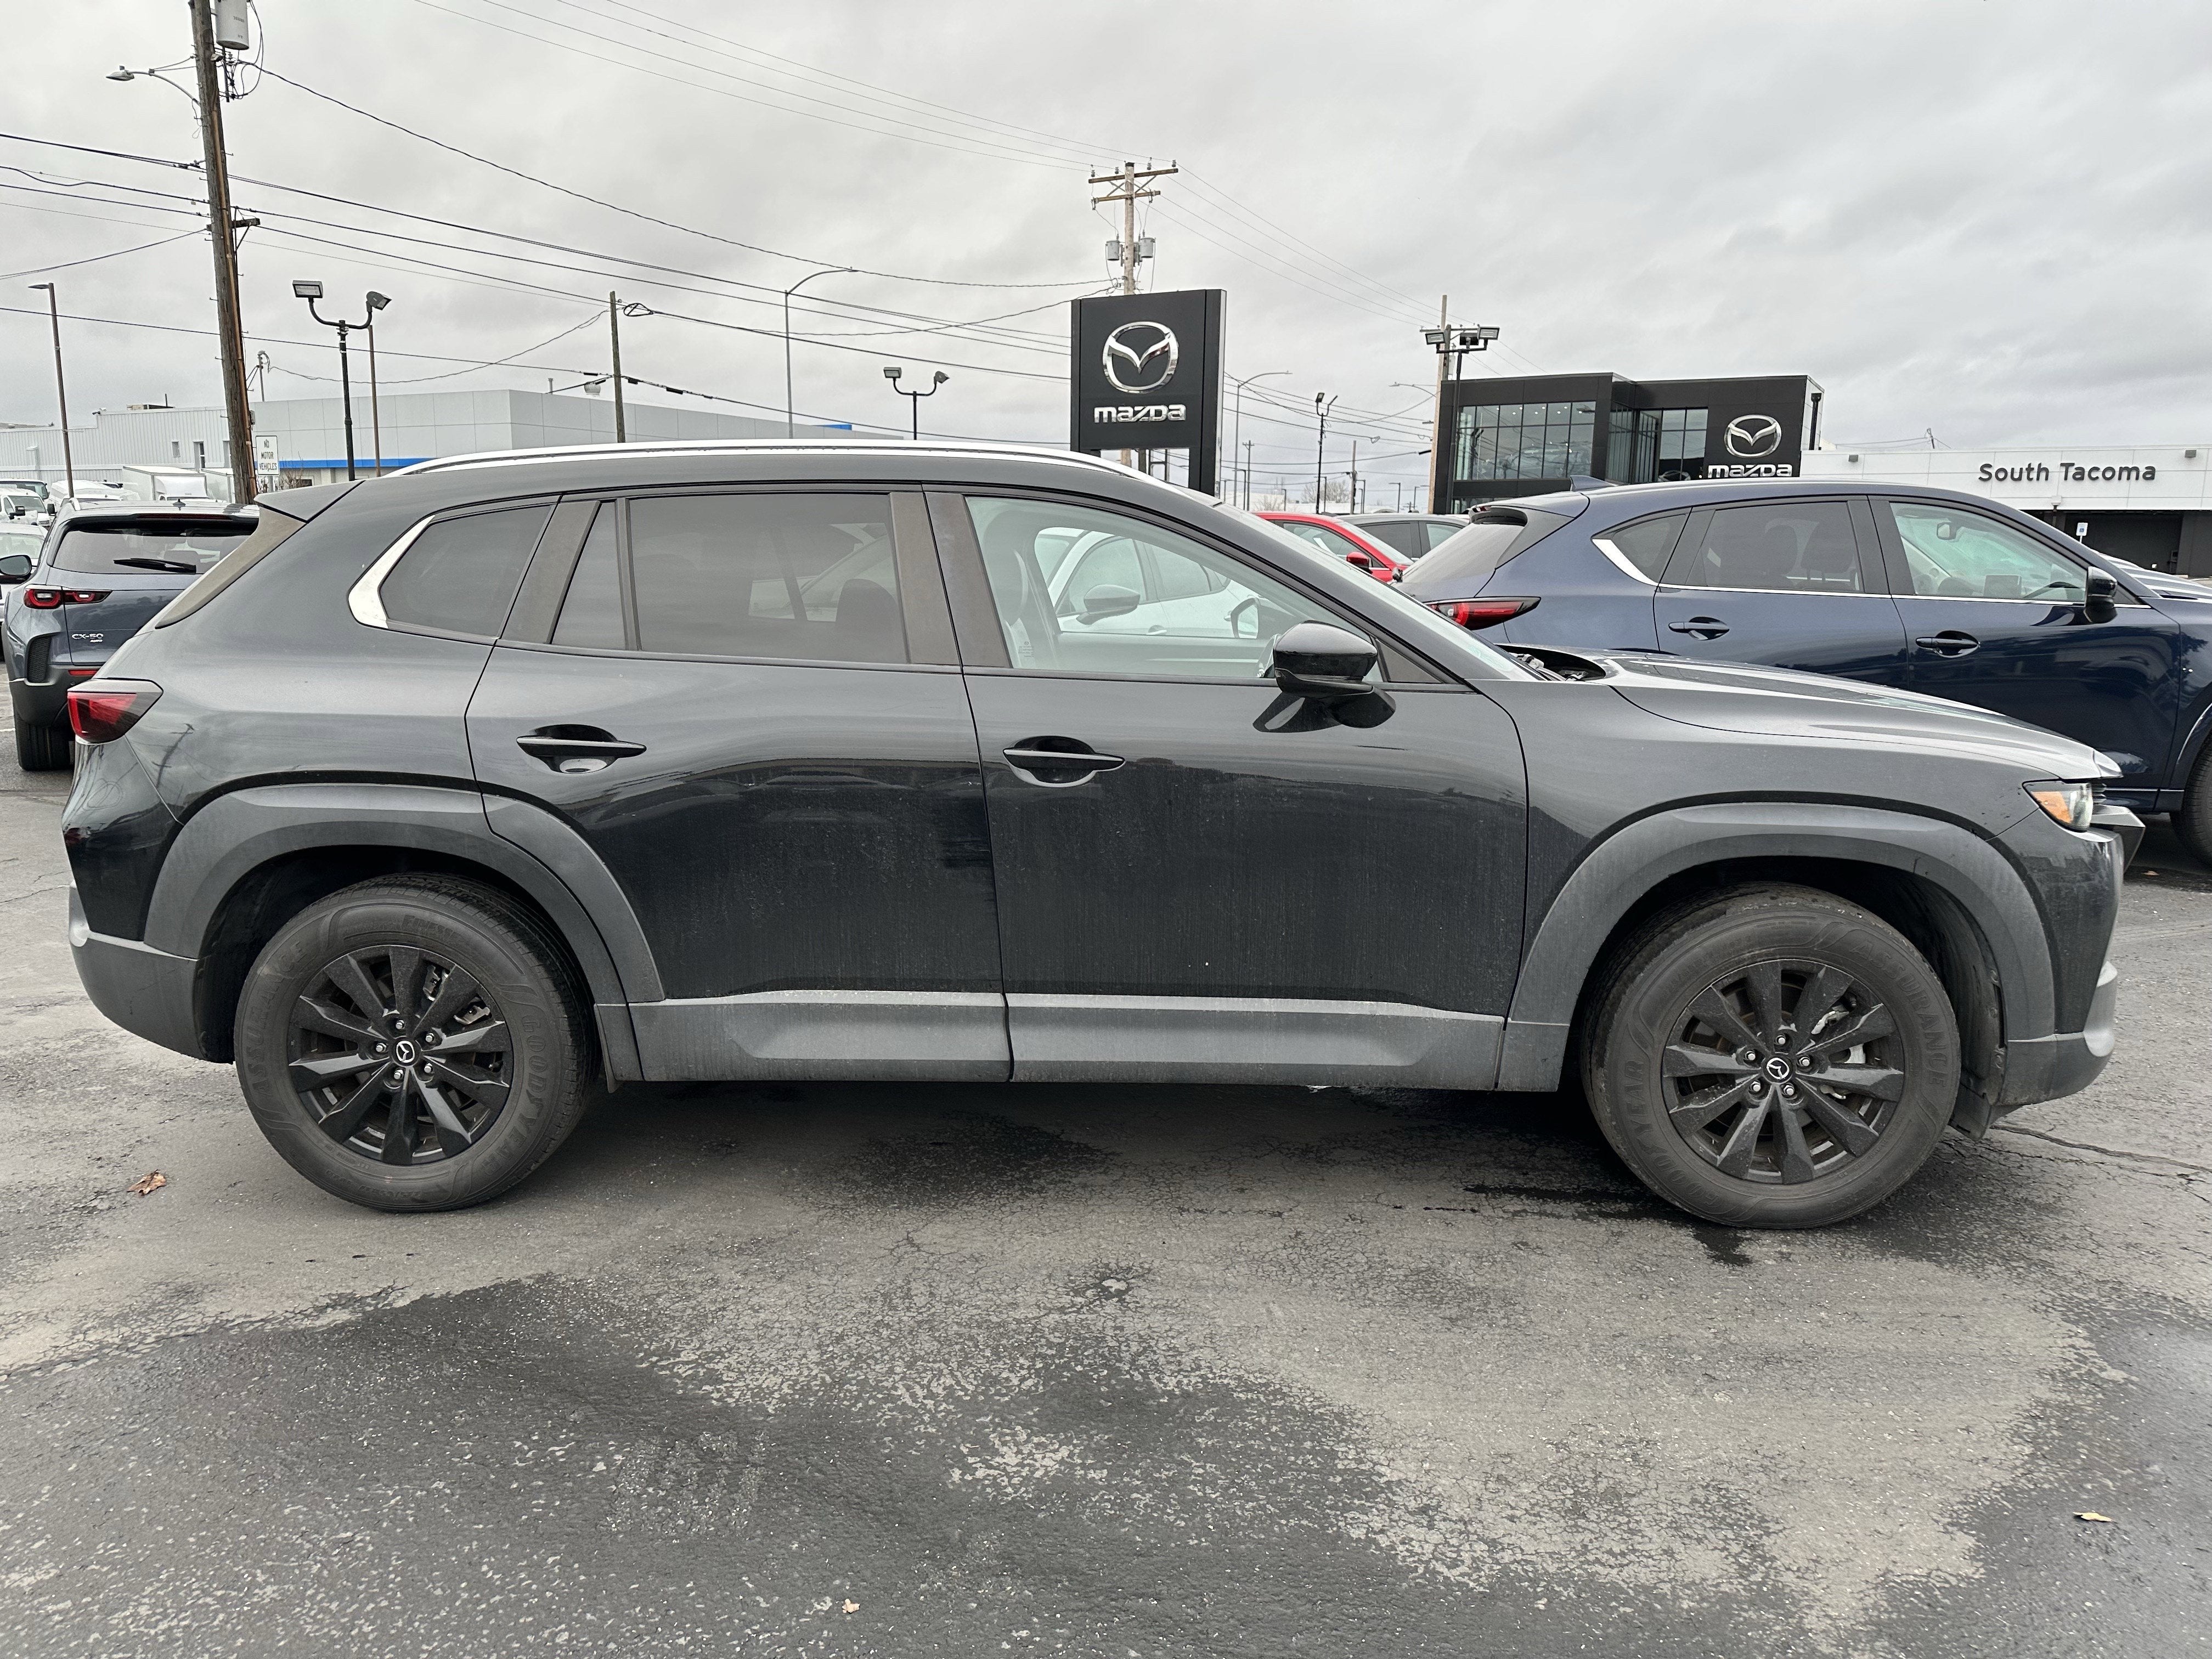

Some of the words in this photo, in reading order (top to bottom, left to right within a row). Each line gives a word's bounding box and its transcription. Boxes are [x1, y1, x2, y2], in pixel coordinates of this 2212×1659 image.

[1094, 404, 1187, 423] mazda
[264, 439, 269, 448] NO
[261, 451, 274, 459] MOTOR
[259, 462, 277, 471] VEHICLES
[1707, 464, 1793, 478] mazda
[1978, 462, 2050, 482] South
[2060, 462, 2156, 481] Tacoma
[478, 1015, 548, 1176] GOODYEAR
[1624, 1059, 1724, 1209] GOODYEAR
